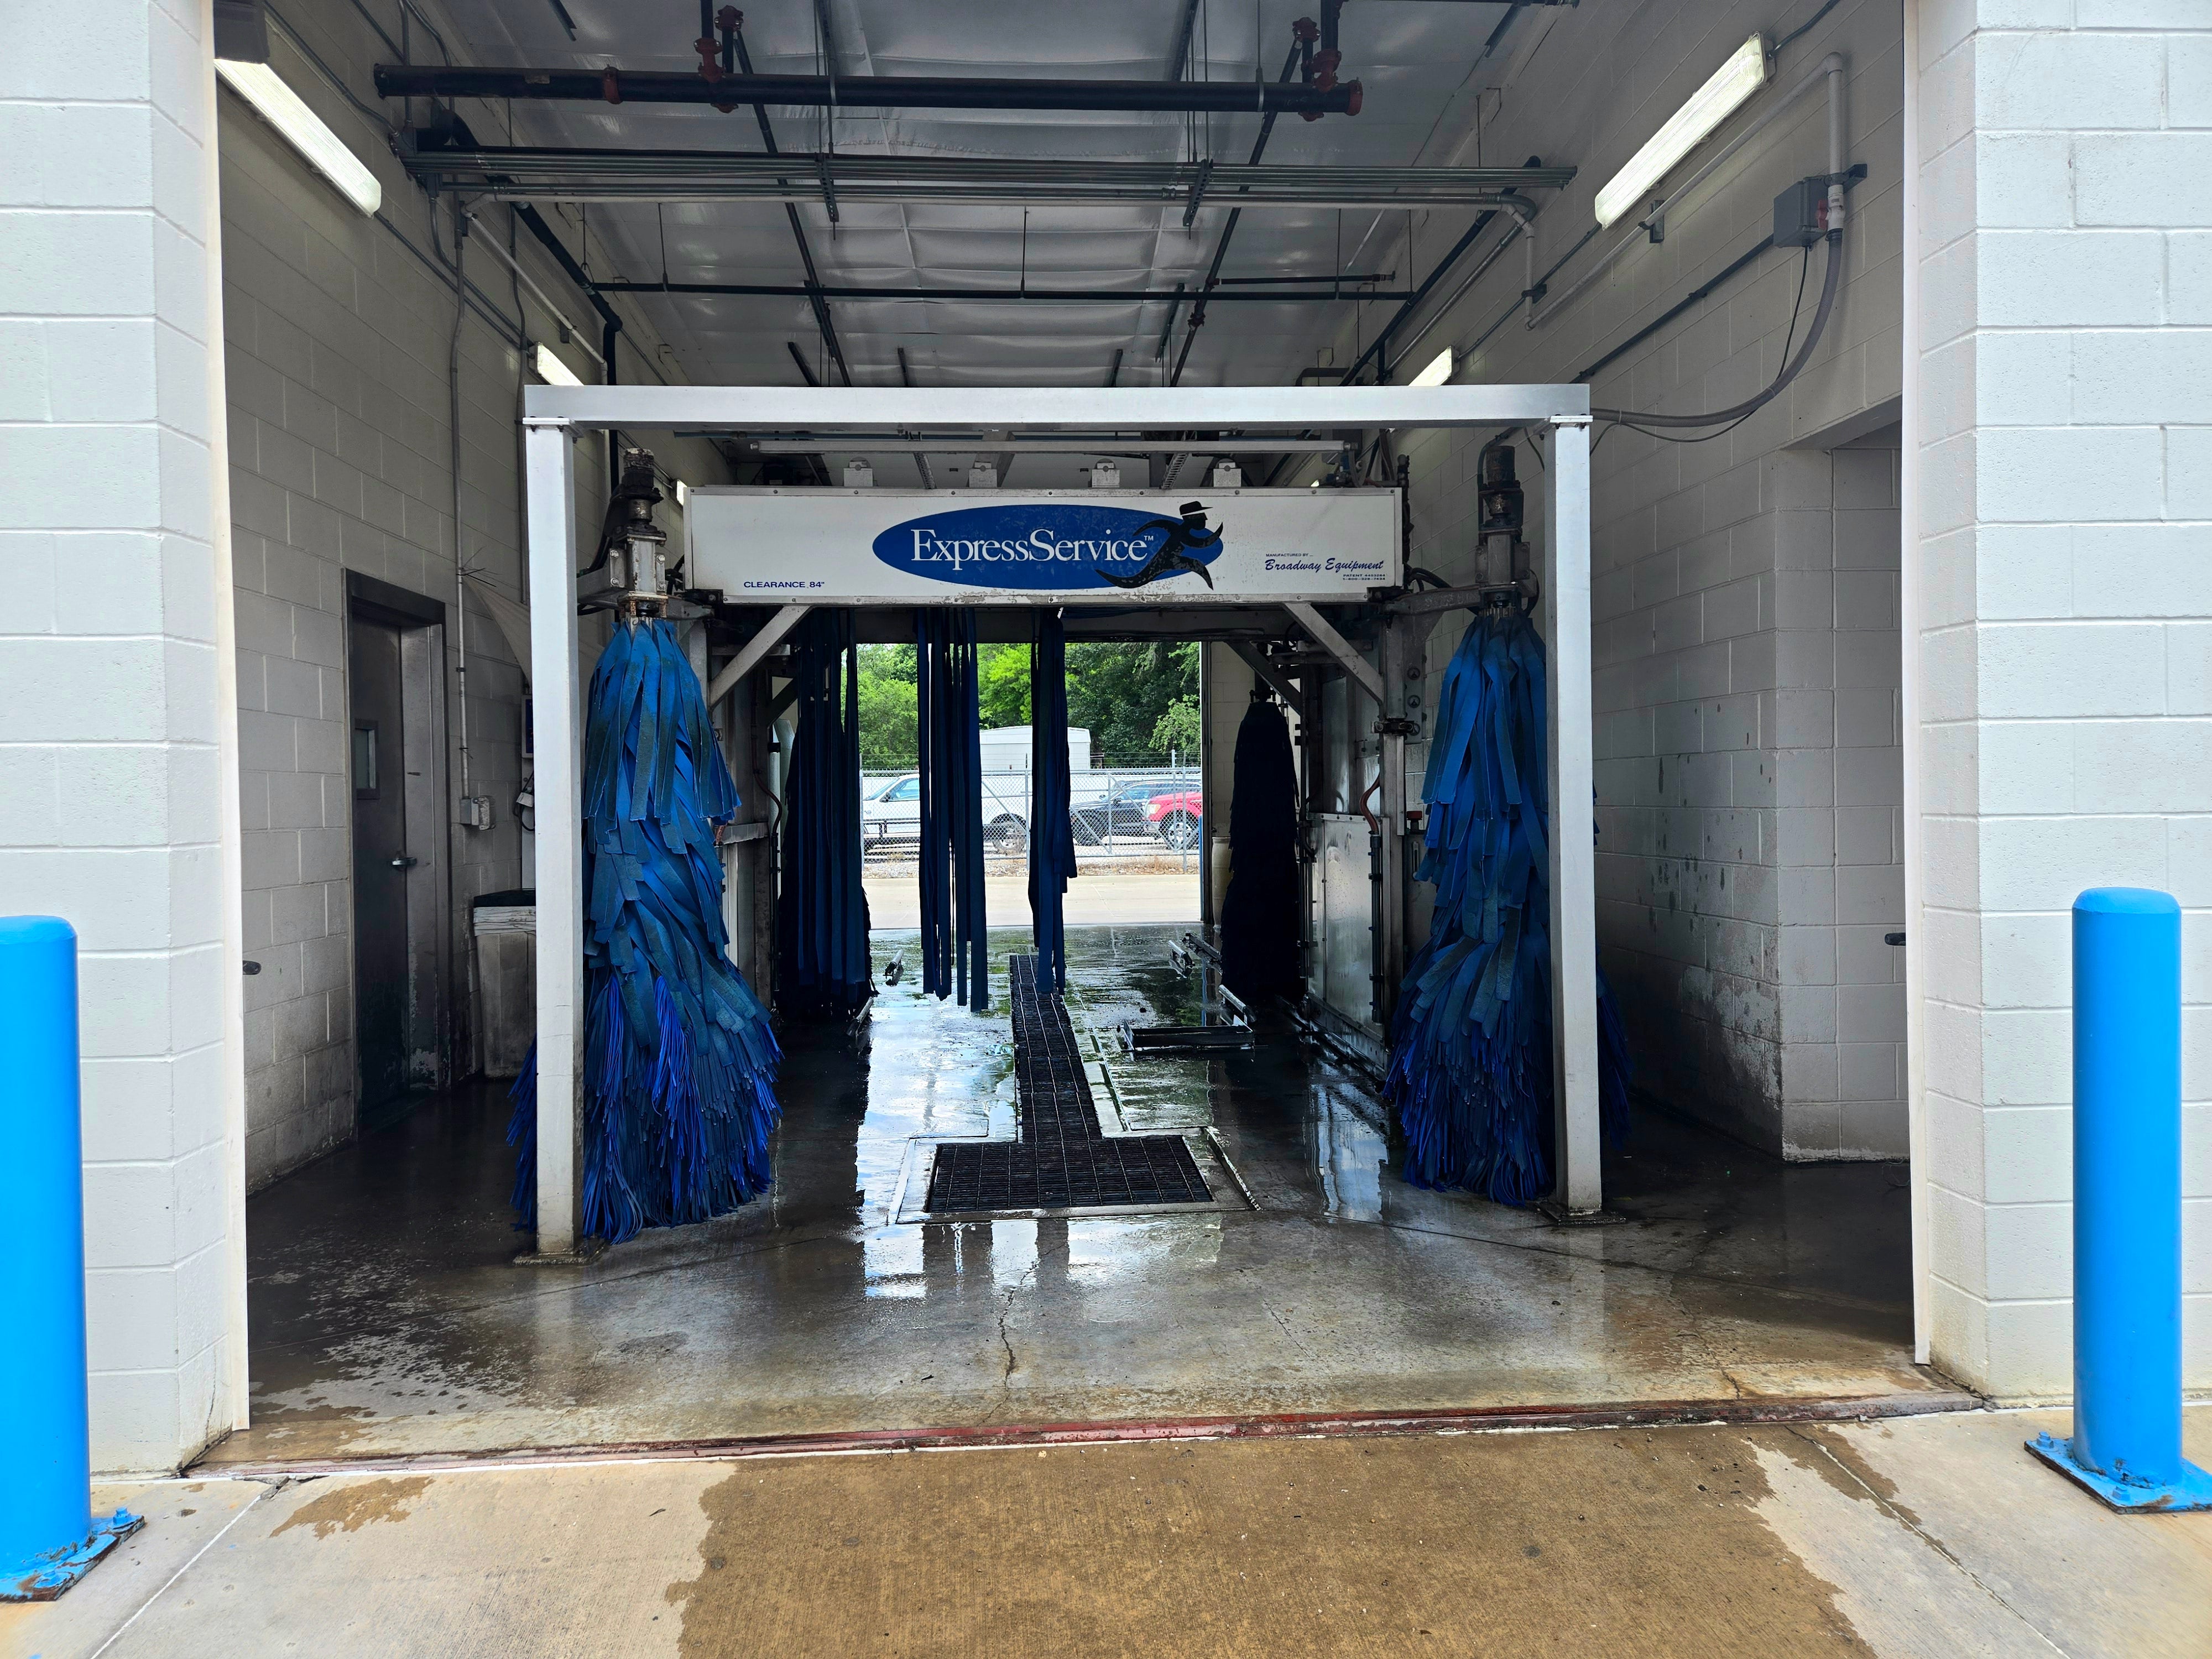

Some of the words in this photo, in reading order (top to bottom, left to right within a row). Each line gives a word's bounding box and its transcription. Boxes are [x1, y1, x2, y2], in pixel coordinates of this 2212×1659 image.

[910, 529, 1147, 570] ExpressService
[1265, 559, 1322, 573] Broadway
[1325, 557, 1384, 573] Equipment
